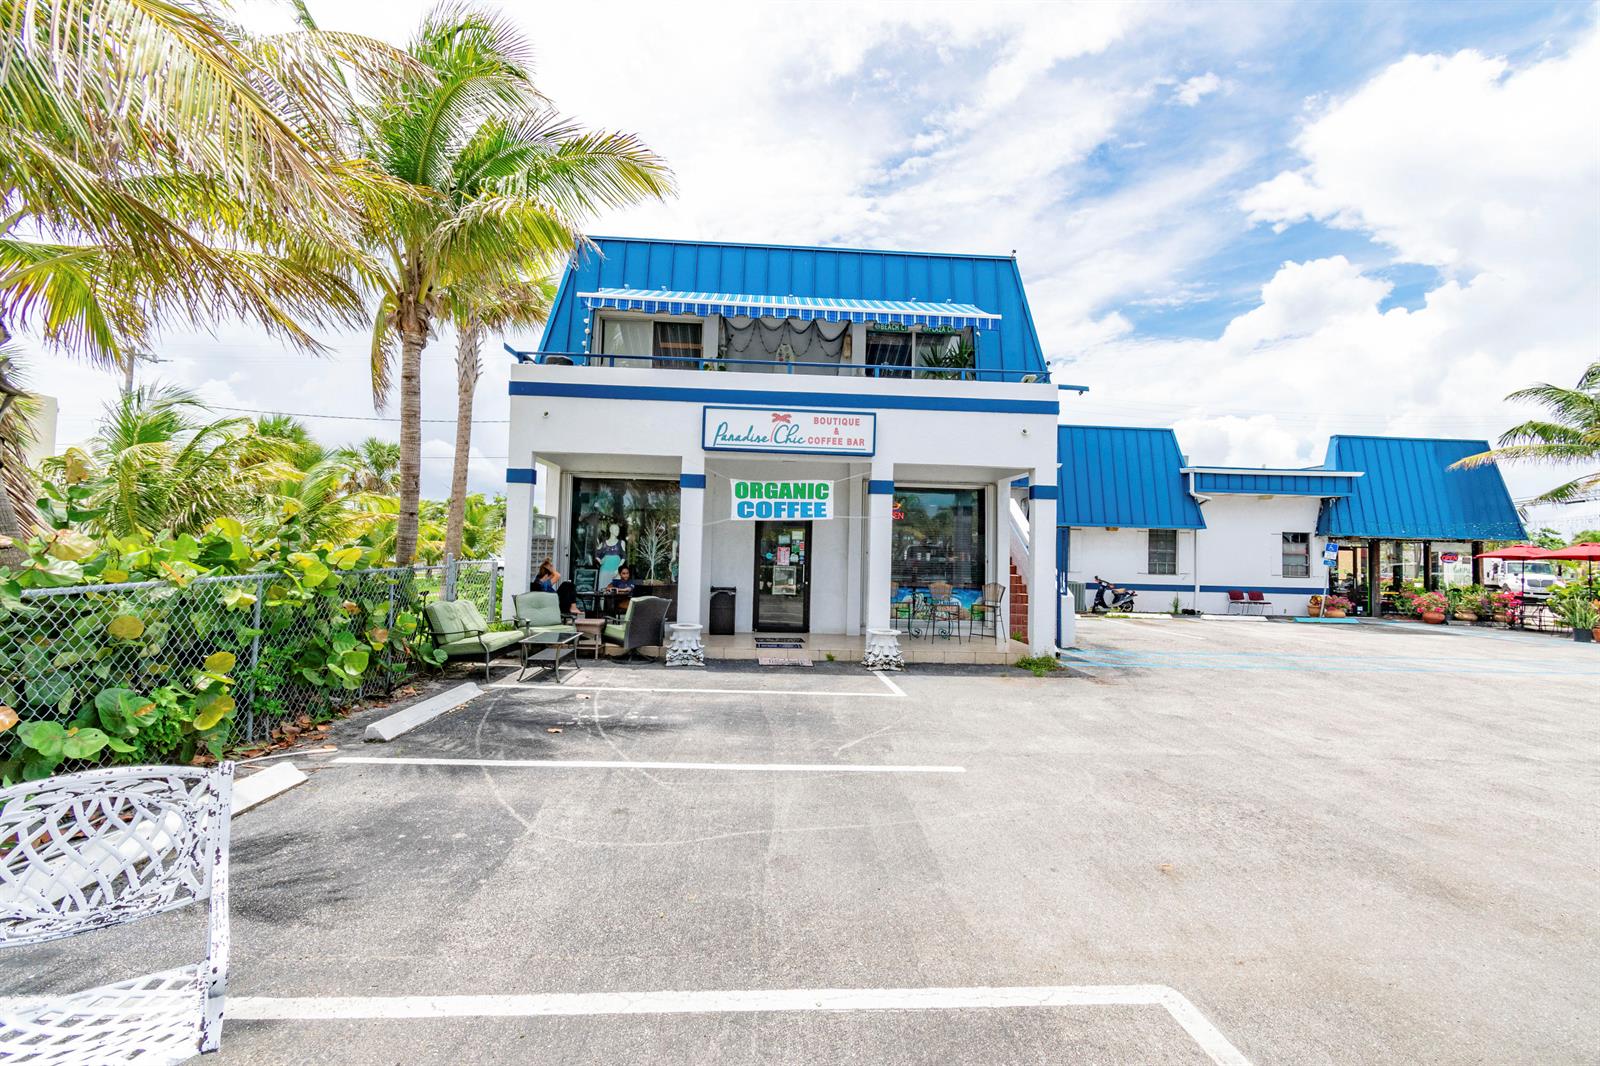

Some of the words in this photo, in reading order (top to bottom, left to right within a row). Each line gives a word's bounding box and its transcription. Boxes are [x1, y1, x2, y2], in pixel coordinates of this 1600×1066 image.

[813, 416, 860, 426] BOUTIQUE
[713, 421, 769, 446] Paradise
[774, 424, 805, 444] Chic
[833, 427, 839, 435] &
[807, 436, 843, 446] COFFEE
[846, 438, 865, 447] BAR
[735, 481, 829, 500] ORGANIC
[737, 501, 827, 518] COFFEE
[892, 511, 904, 520] EN
